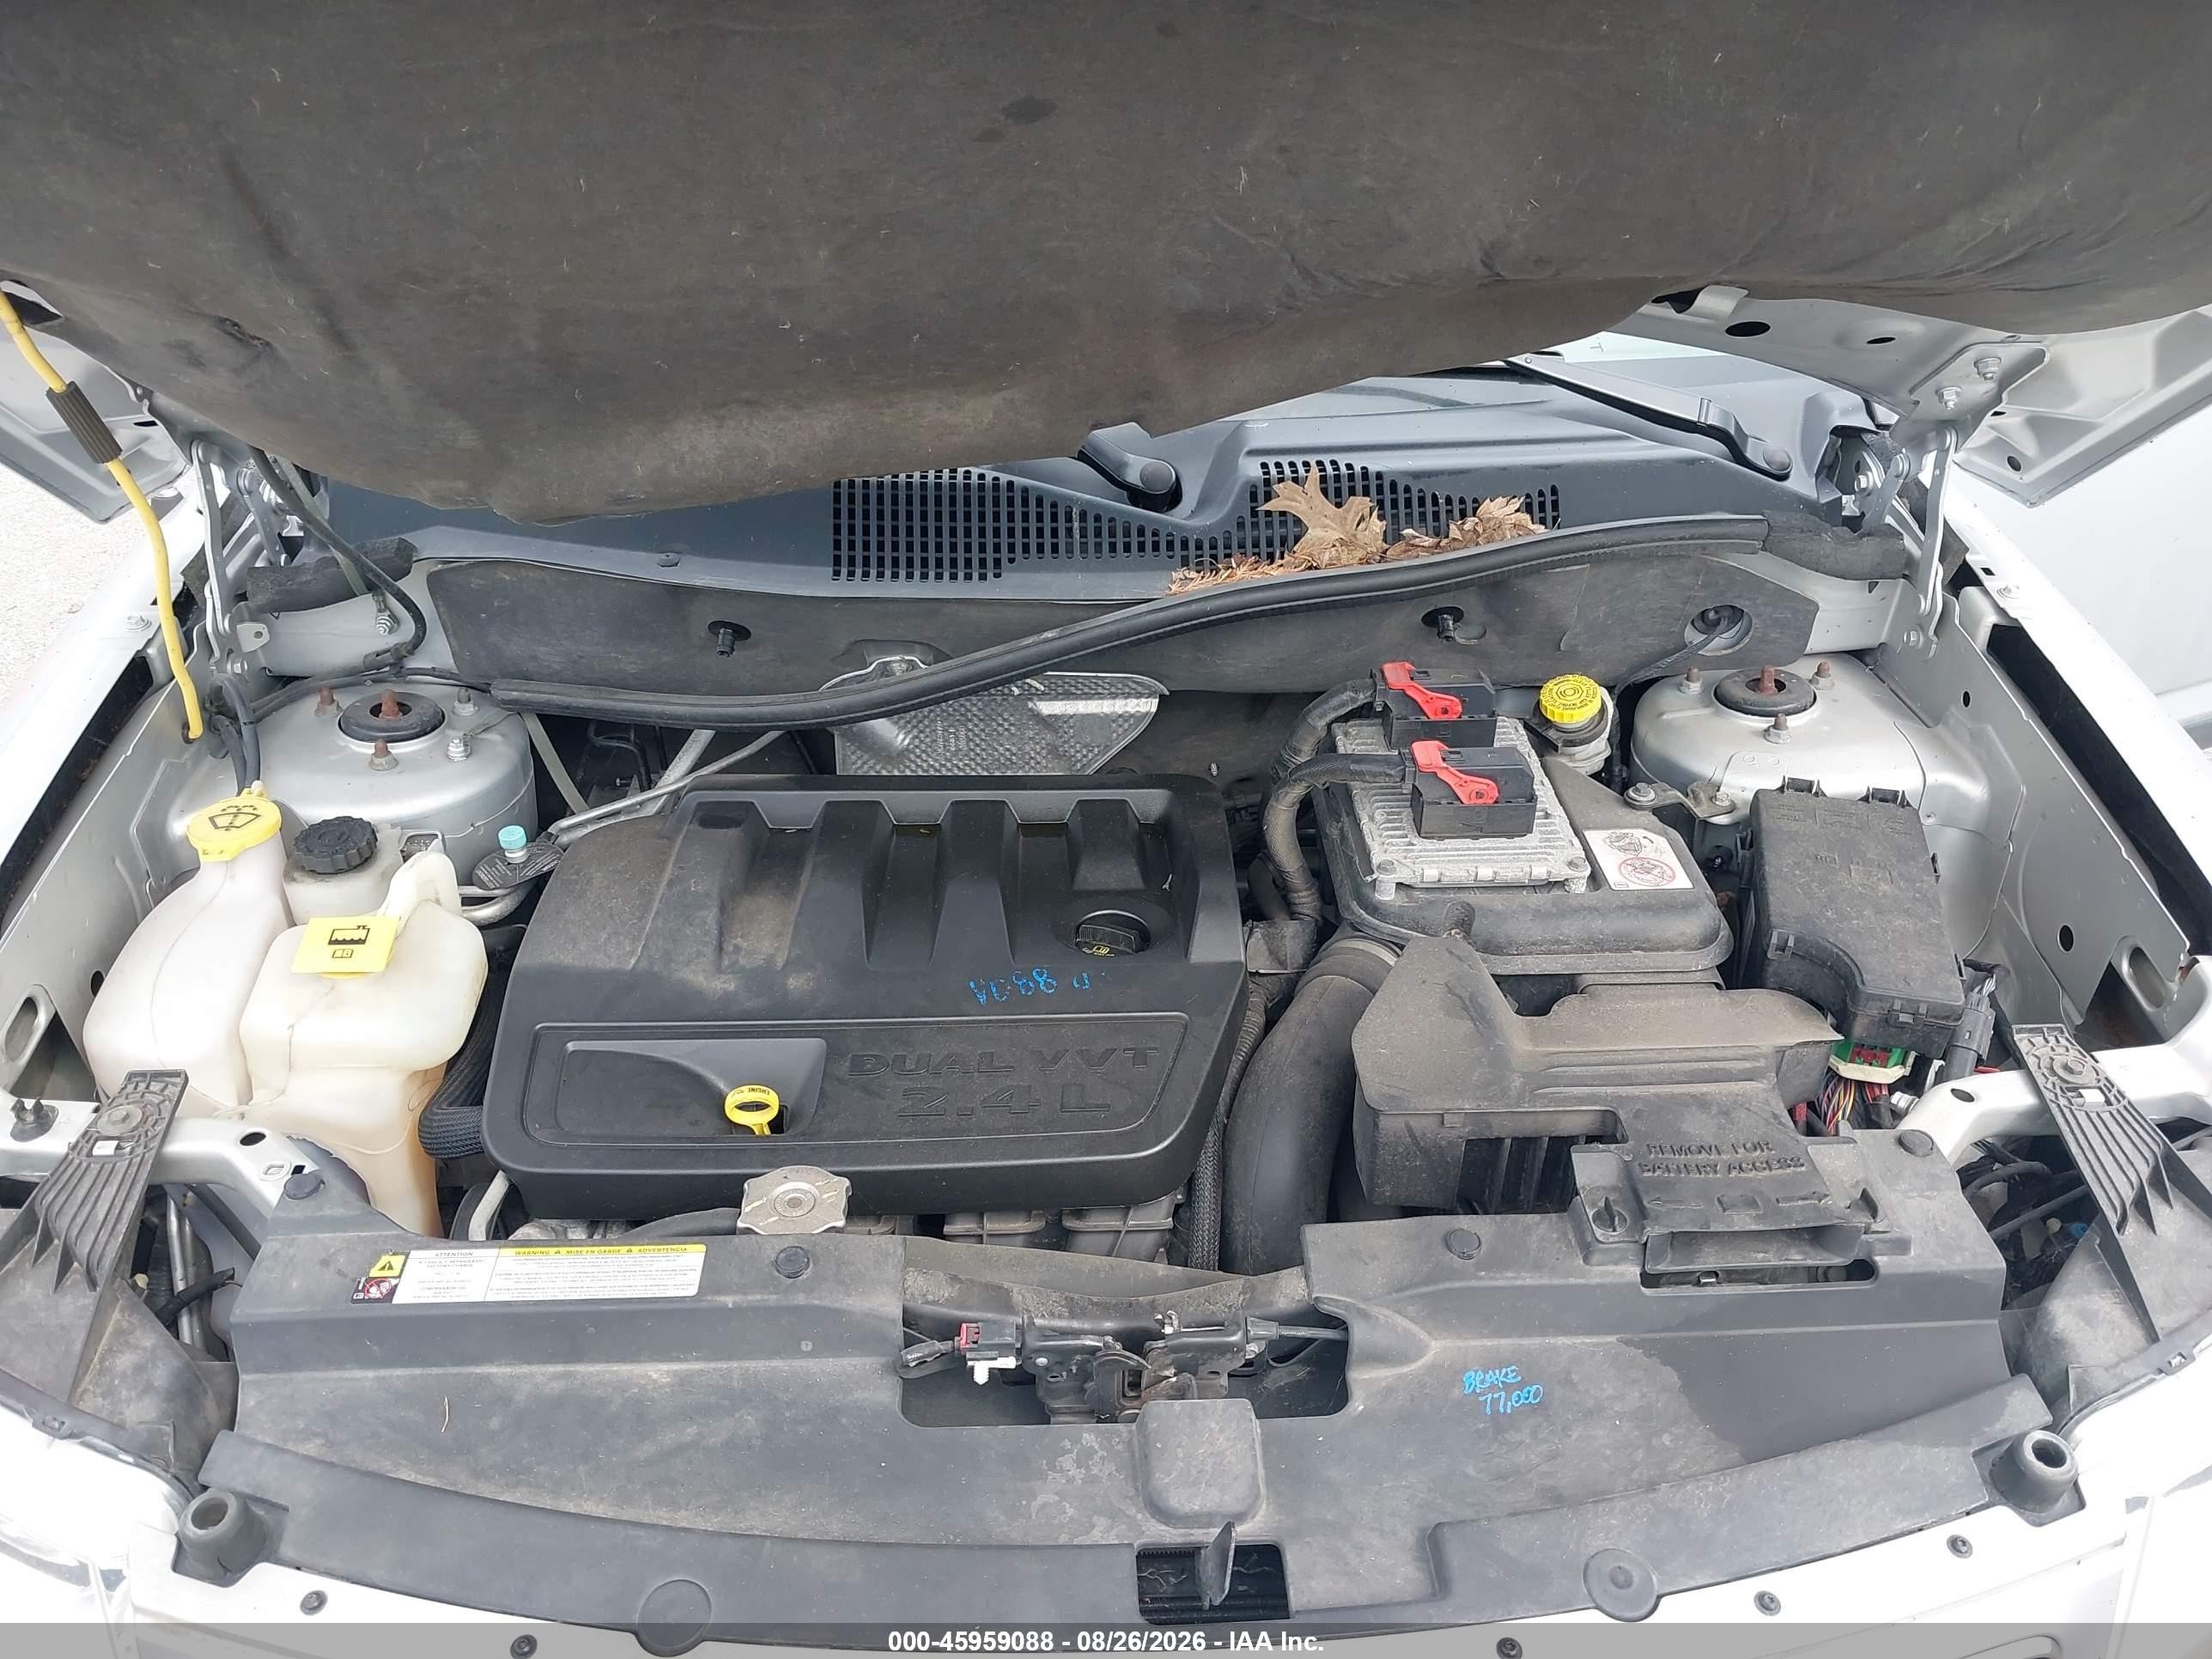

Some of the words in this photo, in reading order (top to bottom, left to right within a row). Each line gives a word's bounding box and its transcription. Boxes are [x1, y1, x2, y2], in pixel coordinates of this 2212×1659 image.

[848, 1050, 1014, 1077] DUAL
[1038, 1045, 1158, 1073] VVT
[897, 1083, 1110, 1118] 2.4L
[1646, 1143, 1725, 1158] REMOVE
[1732, 1139, 1774, 1155] FOR
[1638, 1162, 1720, 1177] BATTERY
[1728, 1157, 1806, 1176] ACCESS
